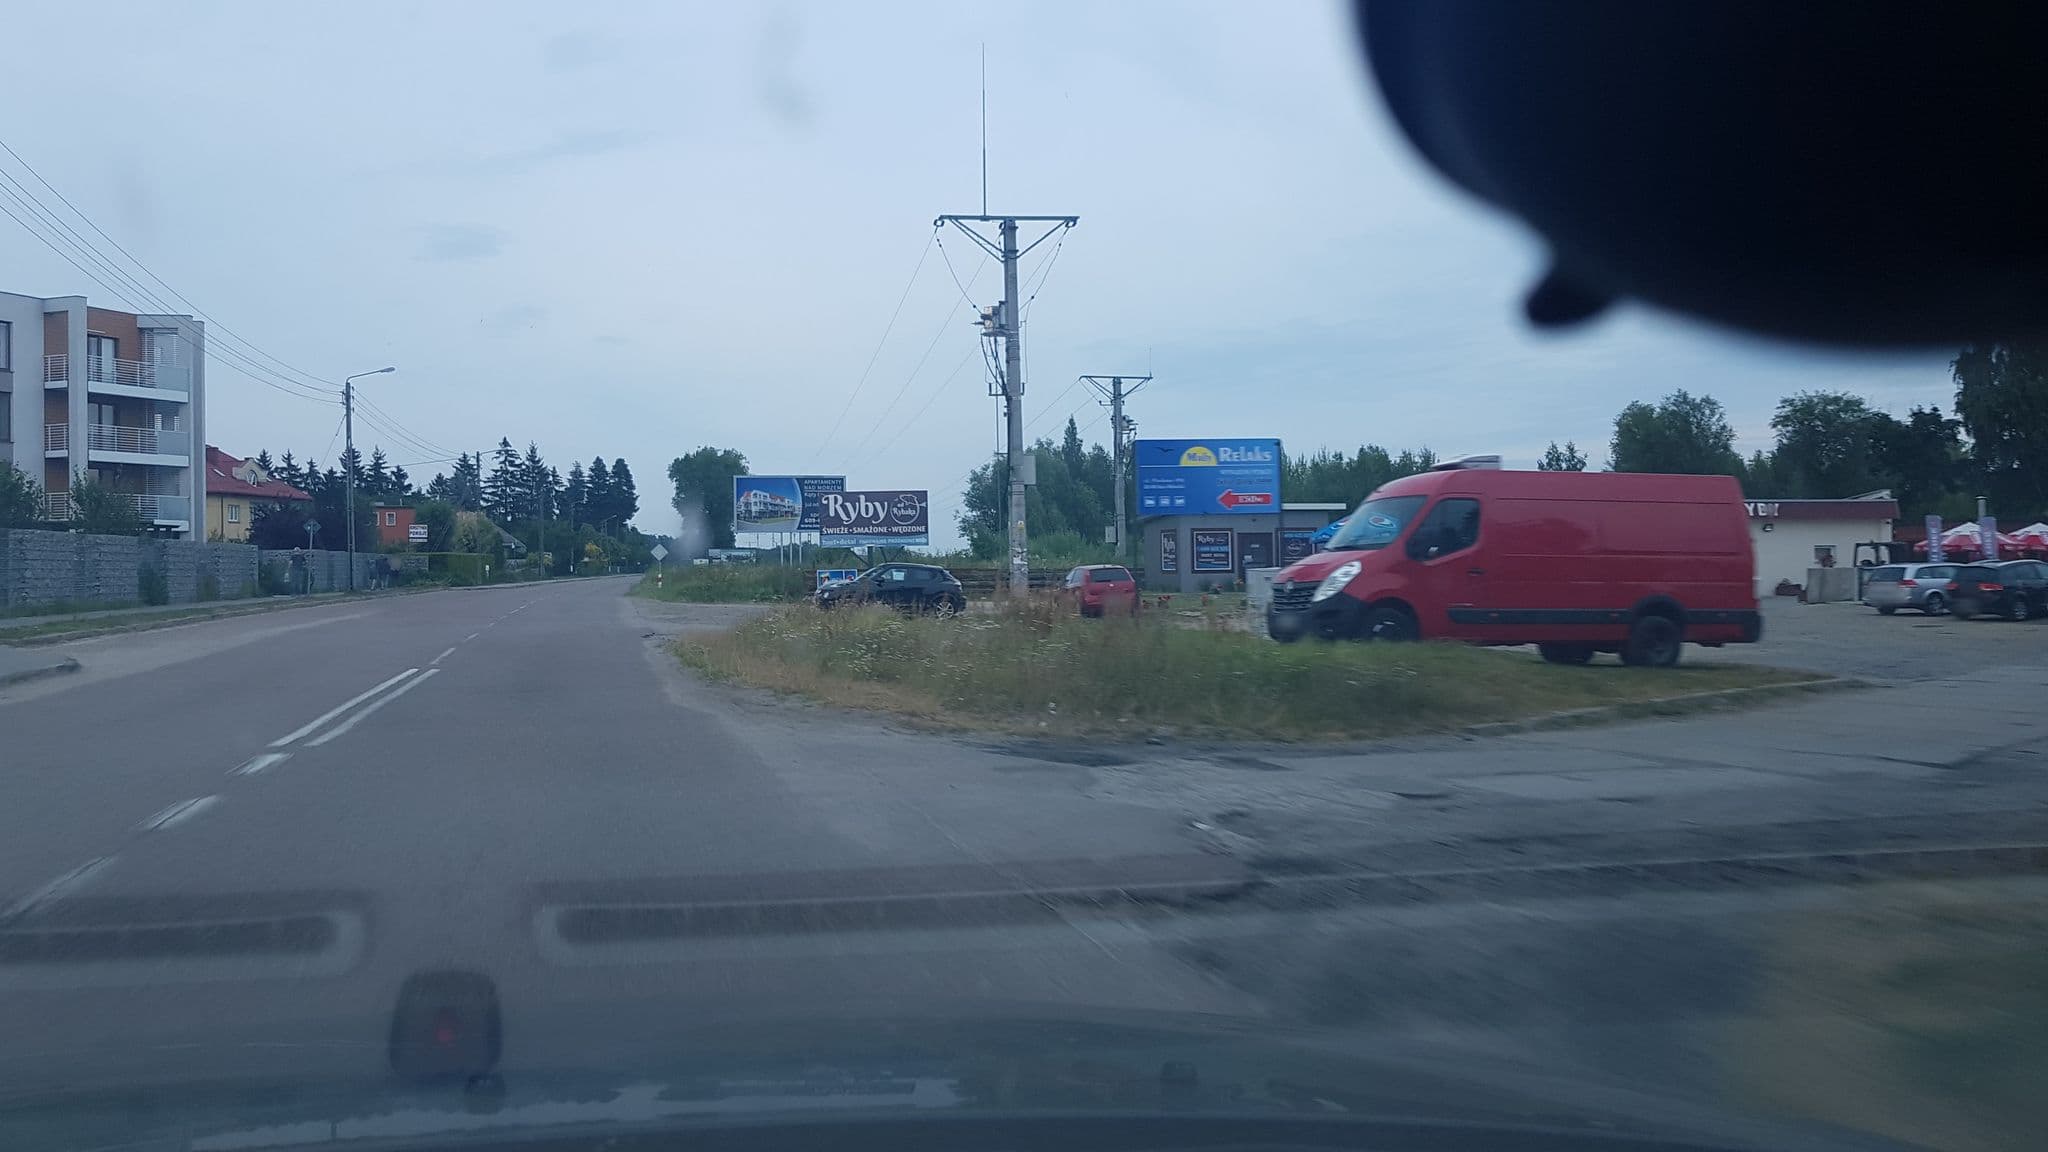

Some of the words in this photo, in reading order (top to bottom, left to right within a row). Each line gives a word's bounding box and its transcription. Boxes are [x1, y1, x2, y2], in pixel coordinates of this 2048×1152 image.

[821, 494, 888, 525] Ryby
[822, 525, 849, 534] ŚWIEŻE
[852, 525, 889, 534] SMAŻONE
[891, 525, 927, 534] WĘDZONE
